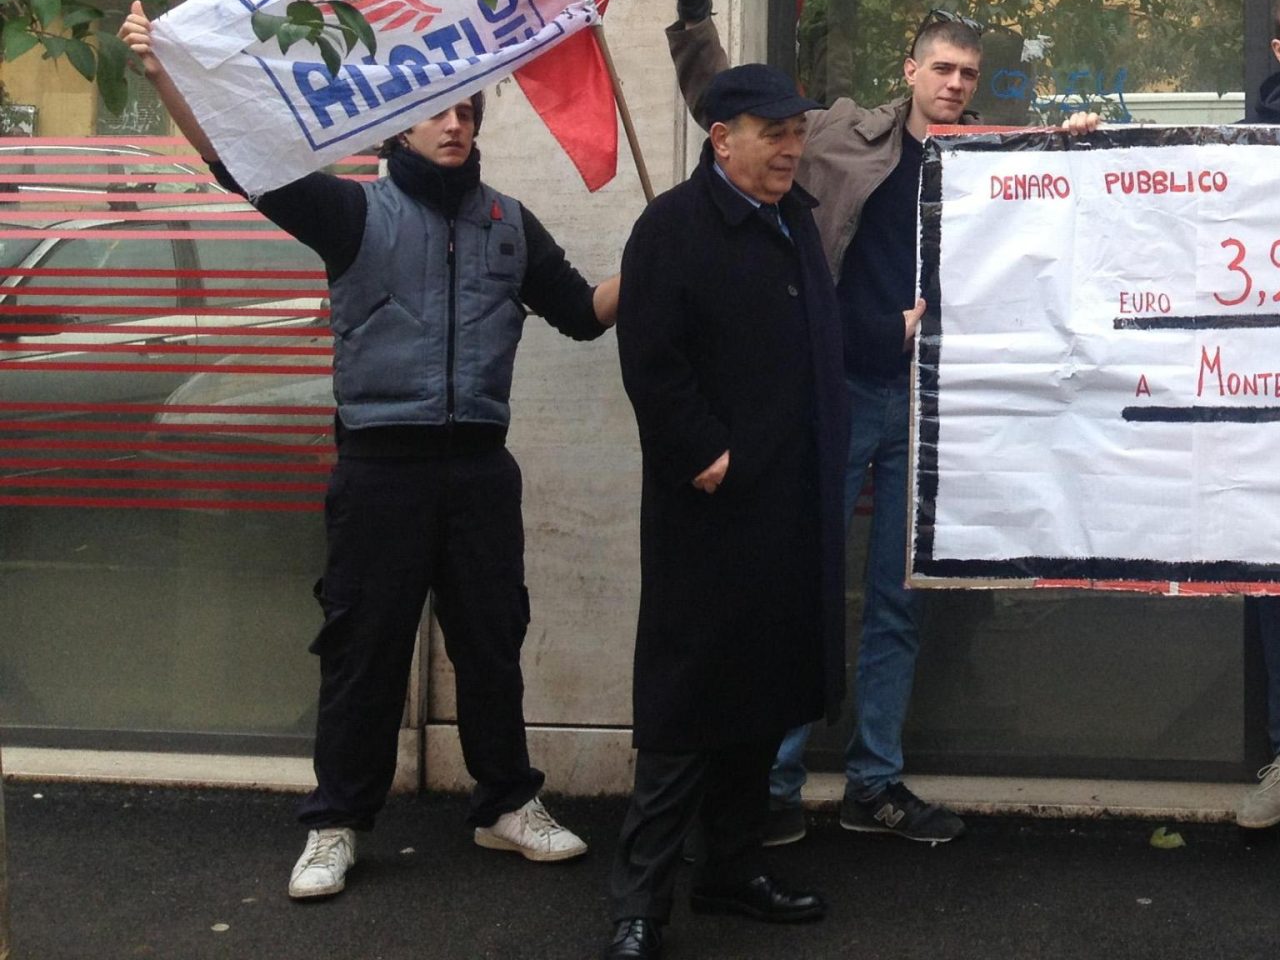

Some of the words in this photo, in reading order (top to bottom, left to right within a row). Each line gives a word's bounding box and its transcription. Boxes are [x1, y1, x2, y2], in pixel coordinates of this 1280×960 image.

[990, 173, 1071, 201] DENARO
[1105, 170, 1229, 195] PUBBLICO
[1119, 291, 1172, 314] EURO
[1135, 377, 1151, 398] A
